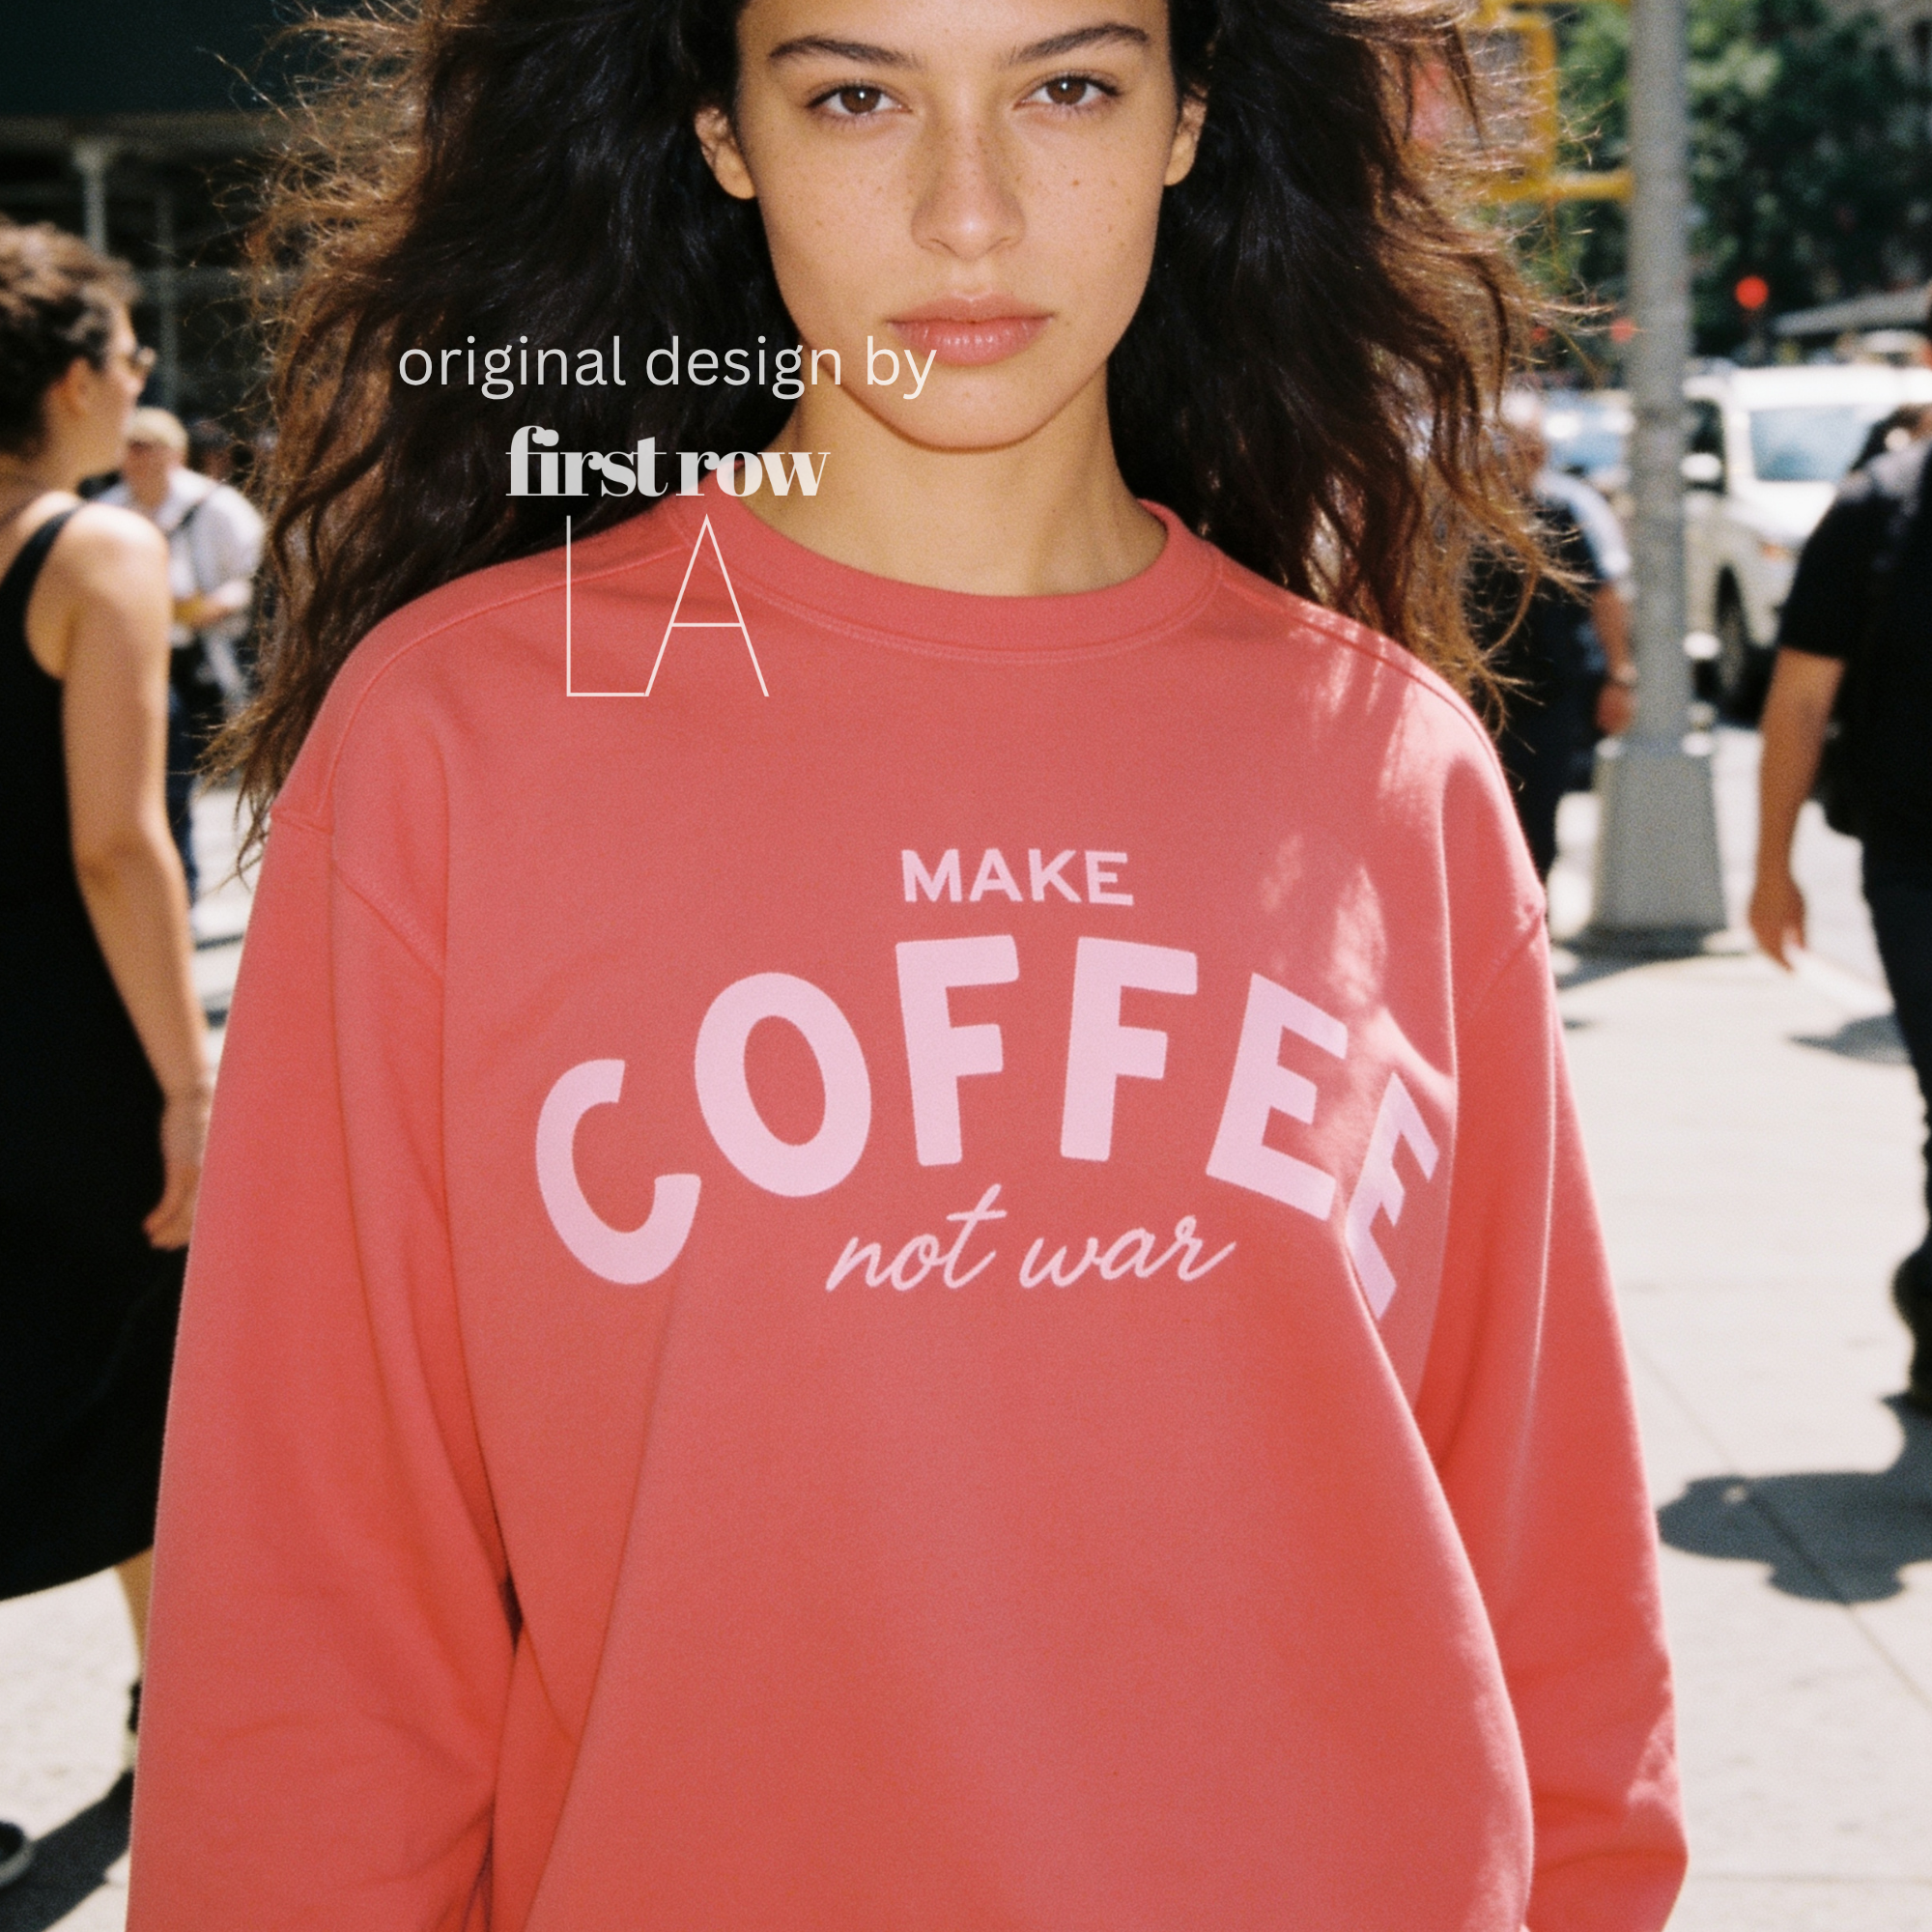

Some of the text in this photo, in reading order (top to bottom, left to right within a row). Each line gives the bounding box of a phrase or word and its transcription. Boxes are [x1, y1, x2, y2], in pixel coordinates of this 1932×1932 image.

[900, 848, 1134, 906] MAKE
[534, 934, 1440, 1321] COFFEE
[825, 1183, 1236, 1292] not war
